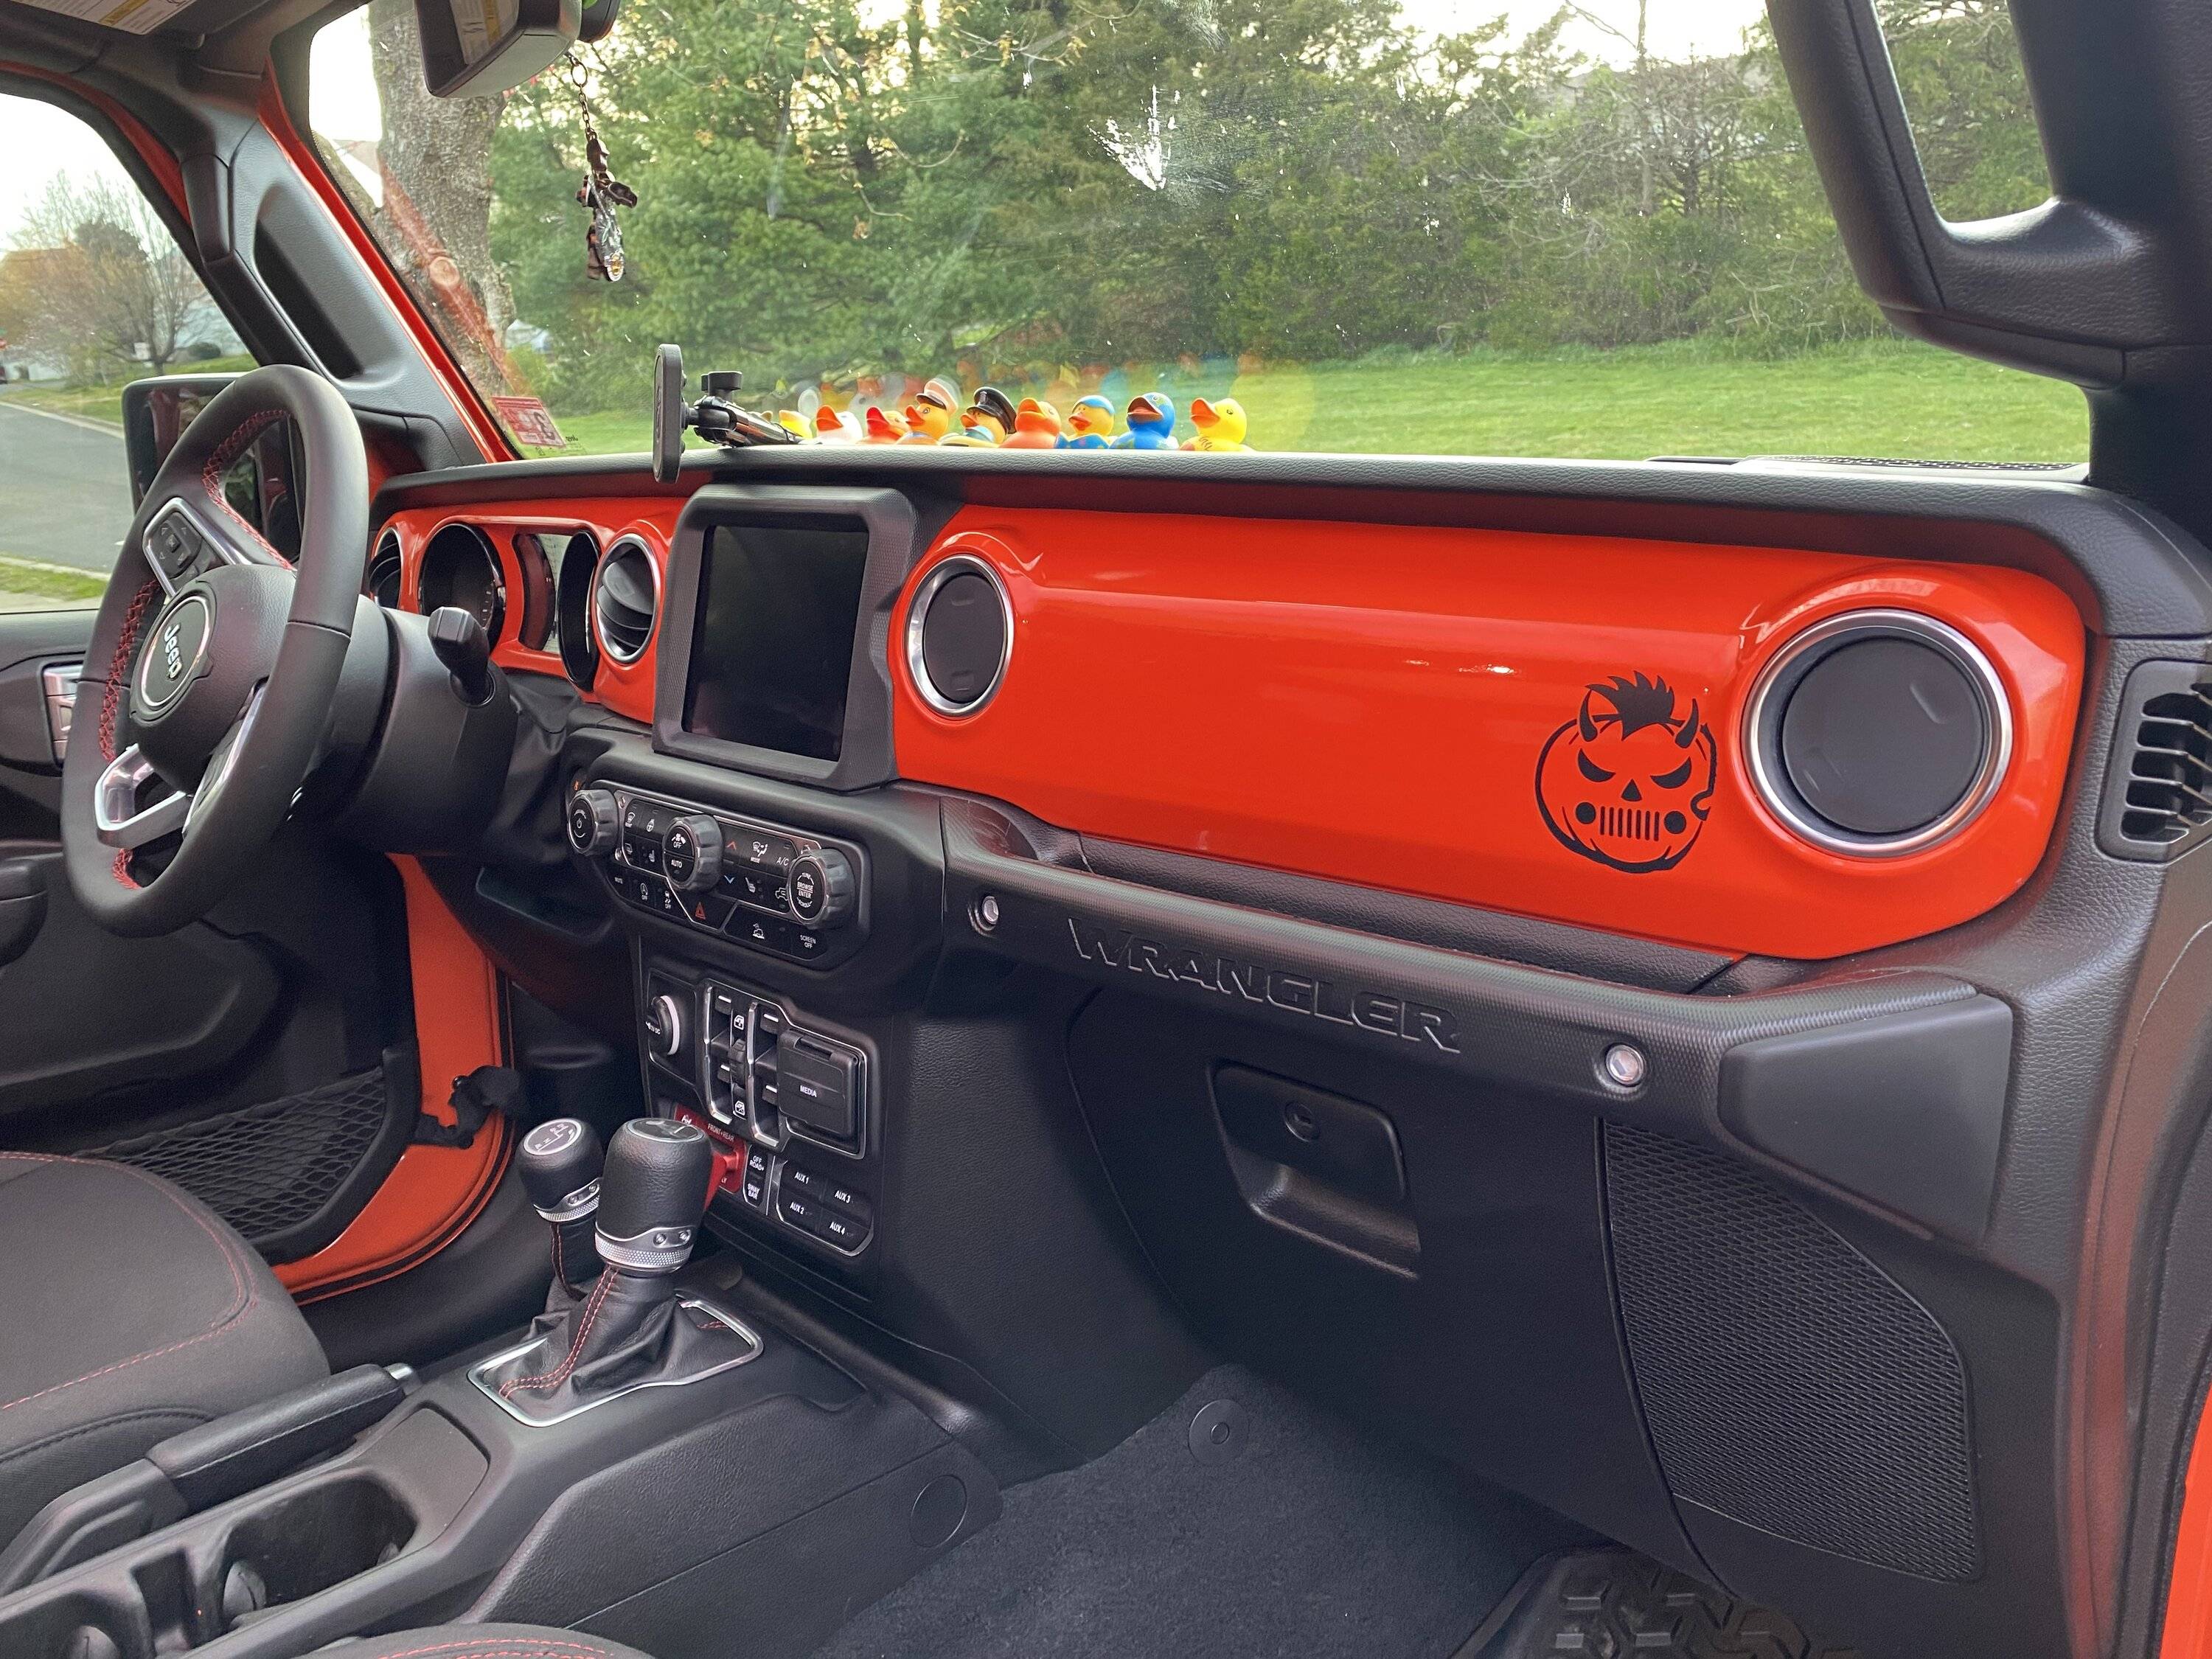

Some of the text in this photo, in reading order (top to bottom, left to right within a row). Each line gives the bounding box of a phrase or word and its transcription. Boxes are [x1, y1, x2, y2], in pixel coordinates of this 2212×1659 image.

[164, 624, 182, 678] Jeep
[673, 841, 682, 849] OFF
[671, 859, 682, 869] AUTO
[776, 857, 789, 866] A/C
[797, 881, 814, 891] BROWSE
[798, 889, 812, 900] ENTER
[800, 934, 816, 945] SCREEN
[804, 942, 813, 950] OFF
[1068, 917, 1461, 1054] WRANGLER
[799, 1085, 818, 1098] MEDIA
[752, 1155, 762, 1164] OFF
[794, 1172, 809, 1185] AUX 1
[747, 1183, 760, 1194] SWAY
[748, 1190, 758, 1200] BAR
[834, 1190, 851, 1203] AUX 3
[789, 1202, 804, 1215] AUX 2
[829, 1221, 846, 1235] AUX 4
